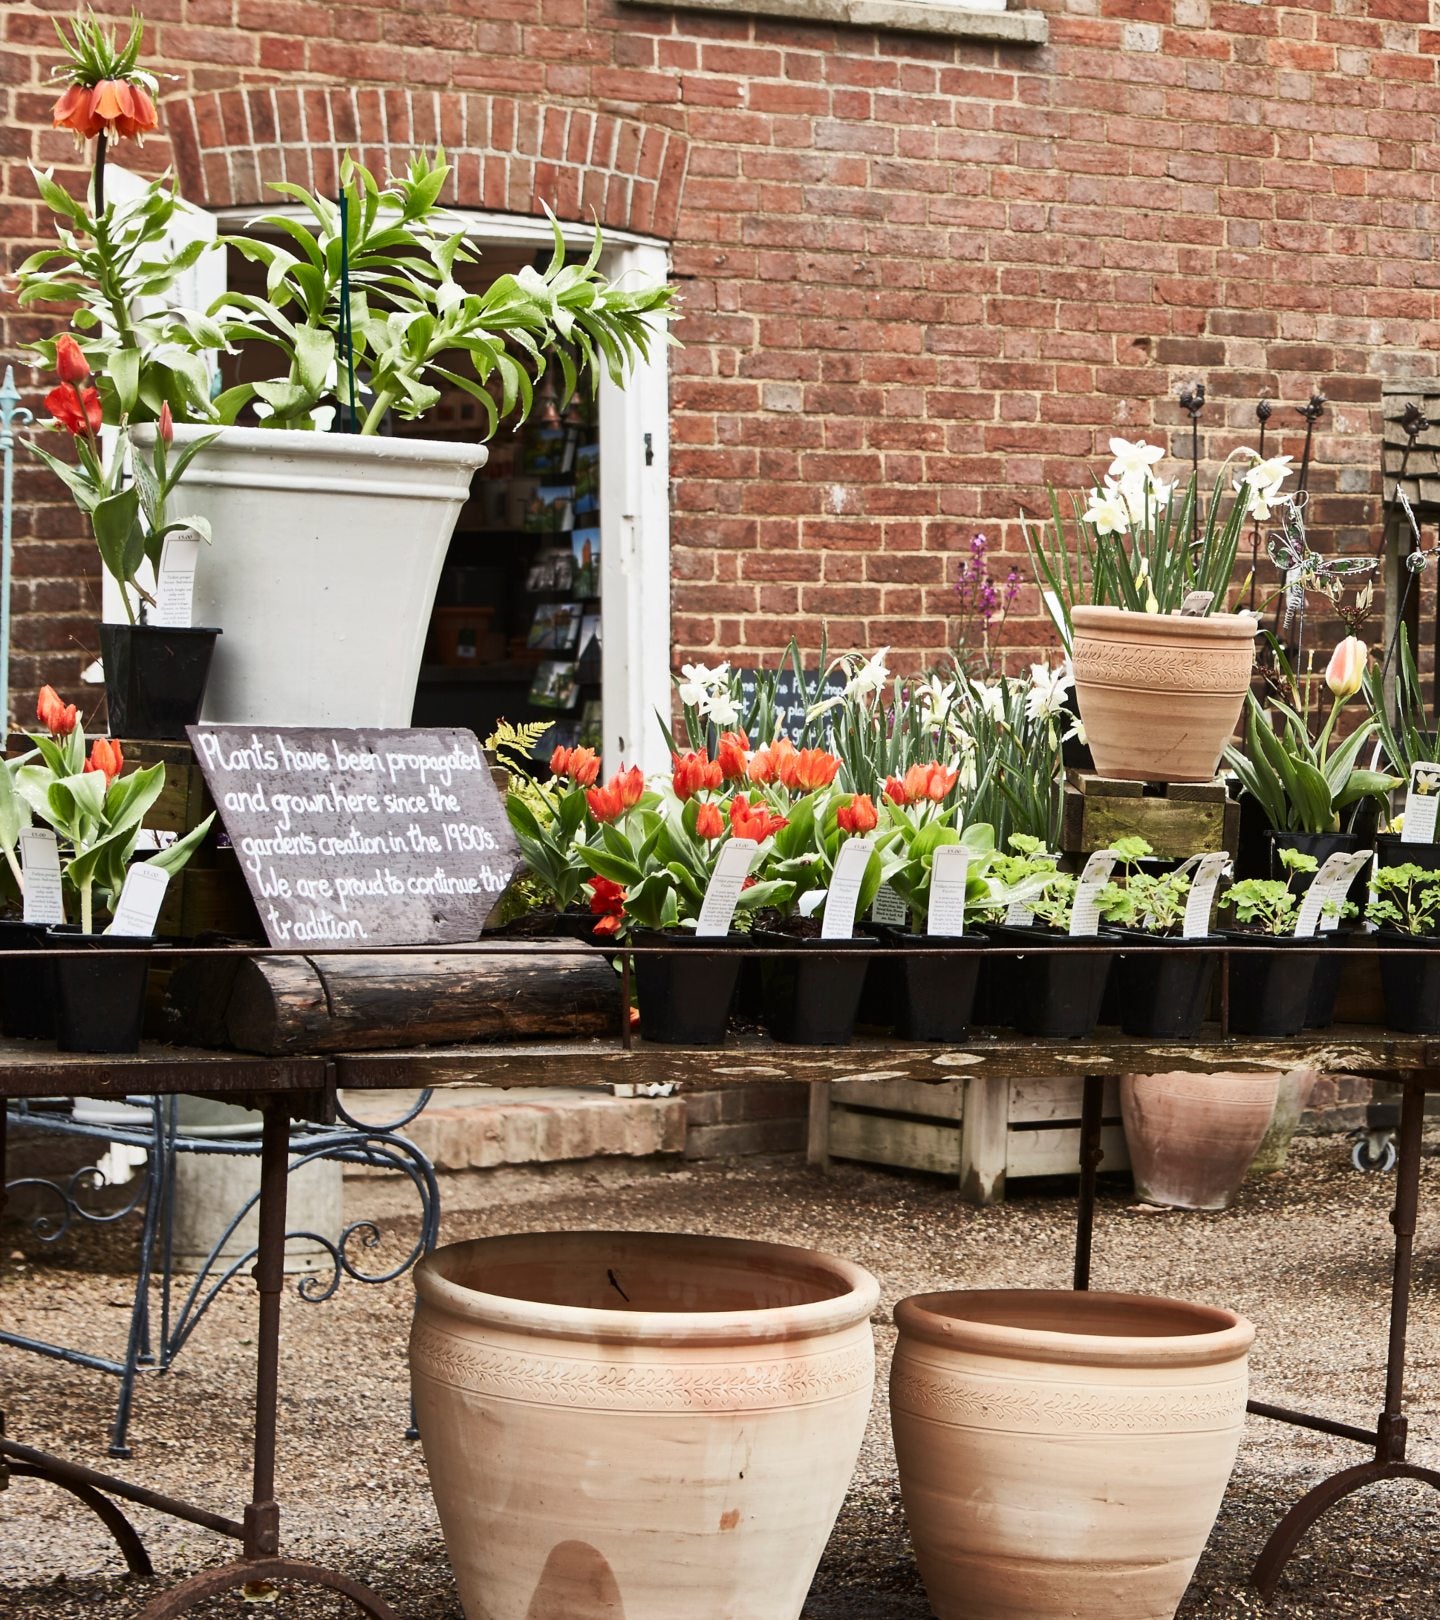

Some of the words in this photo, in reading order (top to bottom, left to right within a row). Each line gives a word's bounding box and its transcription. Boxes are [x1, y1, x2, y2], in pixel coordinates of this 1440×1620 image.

[198, 733, 279, 771] Plants
[276, 734, 331, 771] have
[332, 739, 386, 773] been
[385, 743, 482, 787] propagated
[224, 782, 270, 813] and
[270, 793, 336, 831] grown
[329, 782, 381, 813] here
[383, 793, 430, 814] since
[427, 784, 461, 812] the
[318, 826, 390, 856] creation
[386, 831, 409, 853] in
[407, 823, 442, 853] the
[254, 866, 293, 898] We
[296, 878, 334, 899] are
[334, 868, 389, 912] proud
[385, 867, 405, 895] to
[407, 866, 482, 895] continue
[267, 904, 369, 940] tradition.
